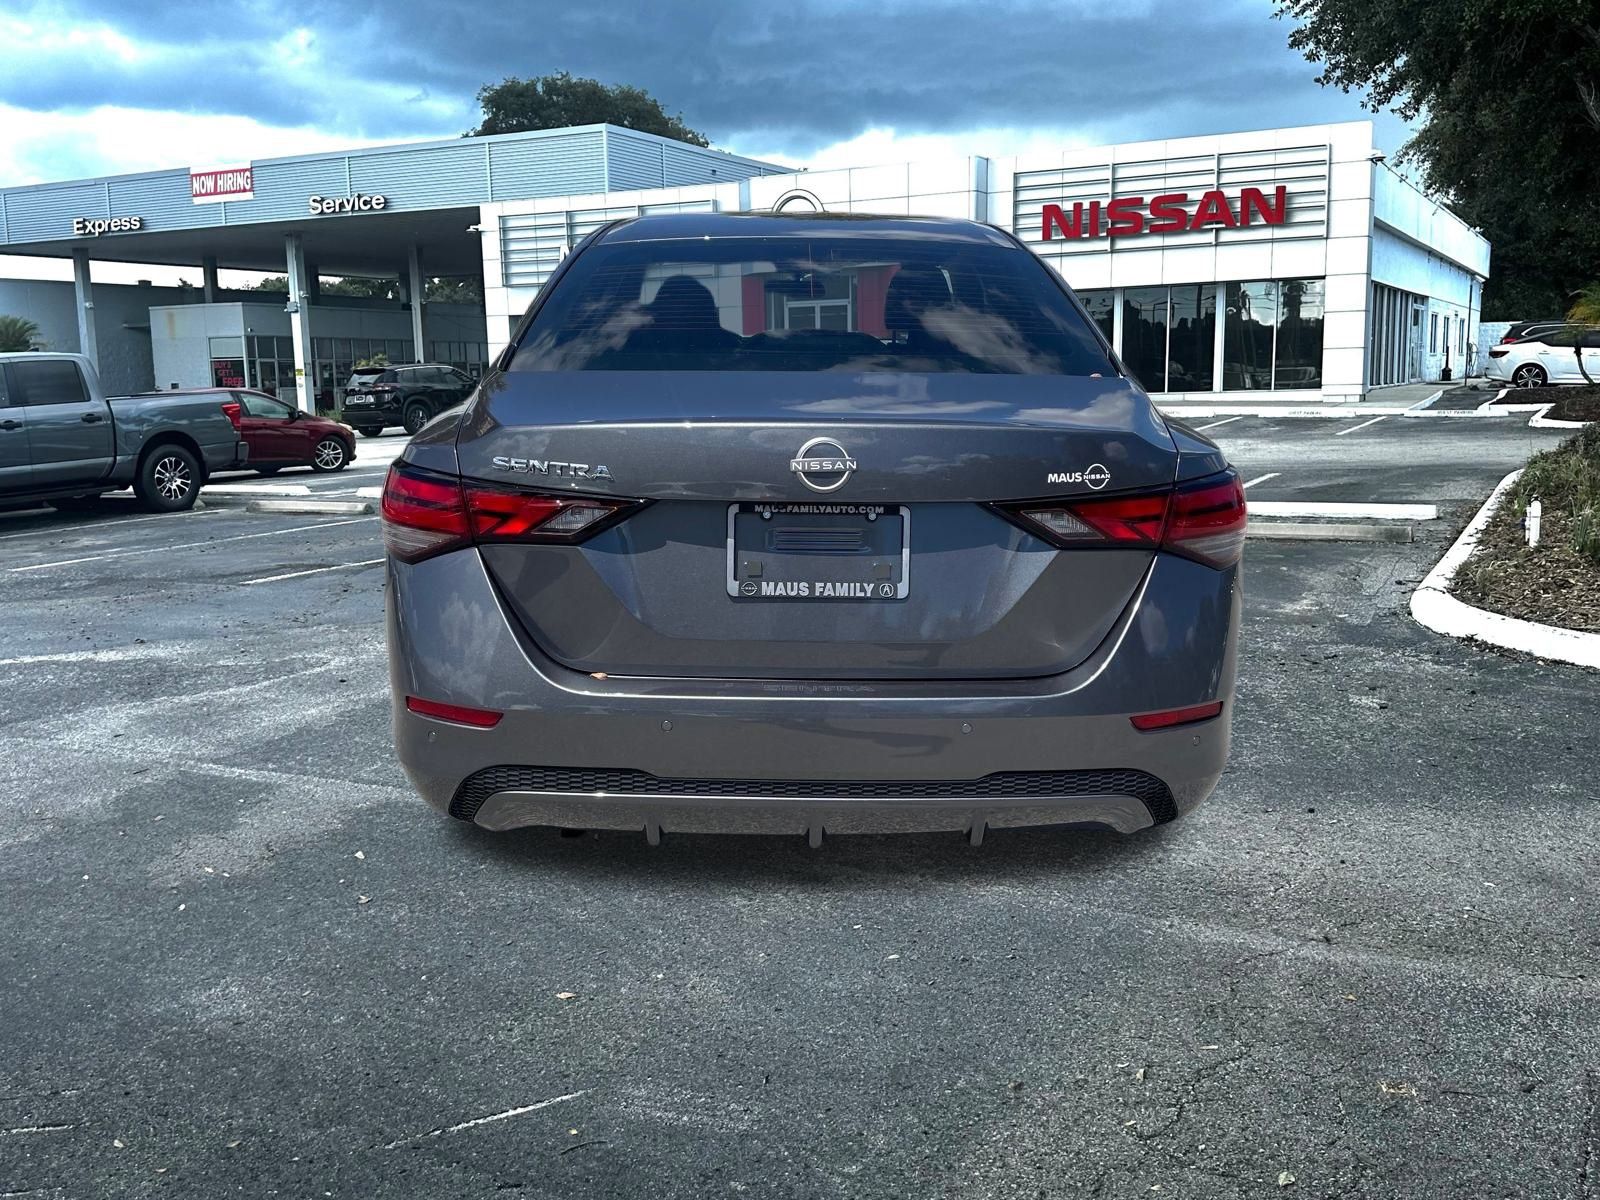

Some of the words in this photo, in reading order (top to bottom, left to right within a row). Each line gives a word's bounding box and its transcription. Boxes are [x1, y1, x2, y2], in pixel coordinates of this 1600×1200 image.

[192, 175, 215, 194] NOW
[217, 170, 251, 192] HIRING
[309, 194, 385, 215] Service
[1042, 185, 1287, 241] NISSAN
[73, 216, 141, 237] Express
[223, 377, 244, 387] FREE
[492, 456, 615, 481] SENTRA
[791, 460, 857, 471] NISSAN
[1047, 472, 1083, 484] MAUS
[761, 581, 809, 596] MAUS
[815, 582, 875, 597] FAMILY
